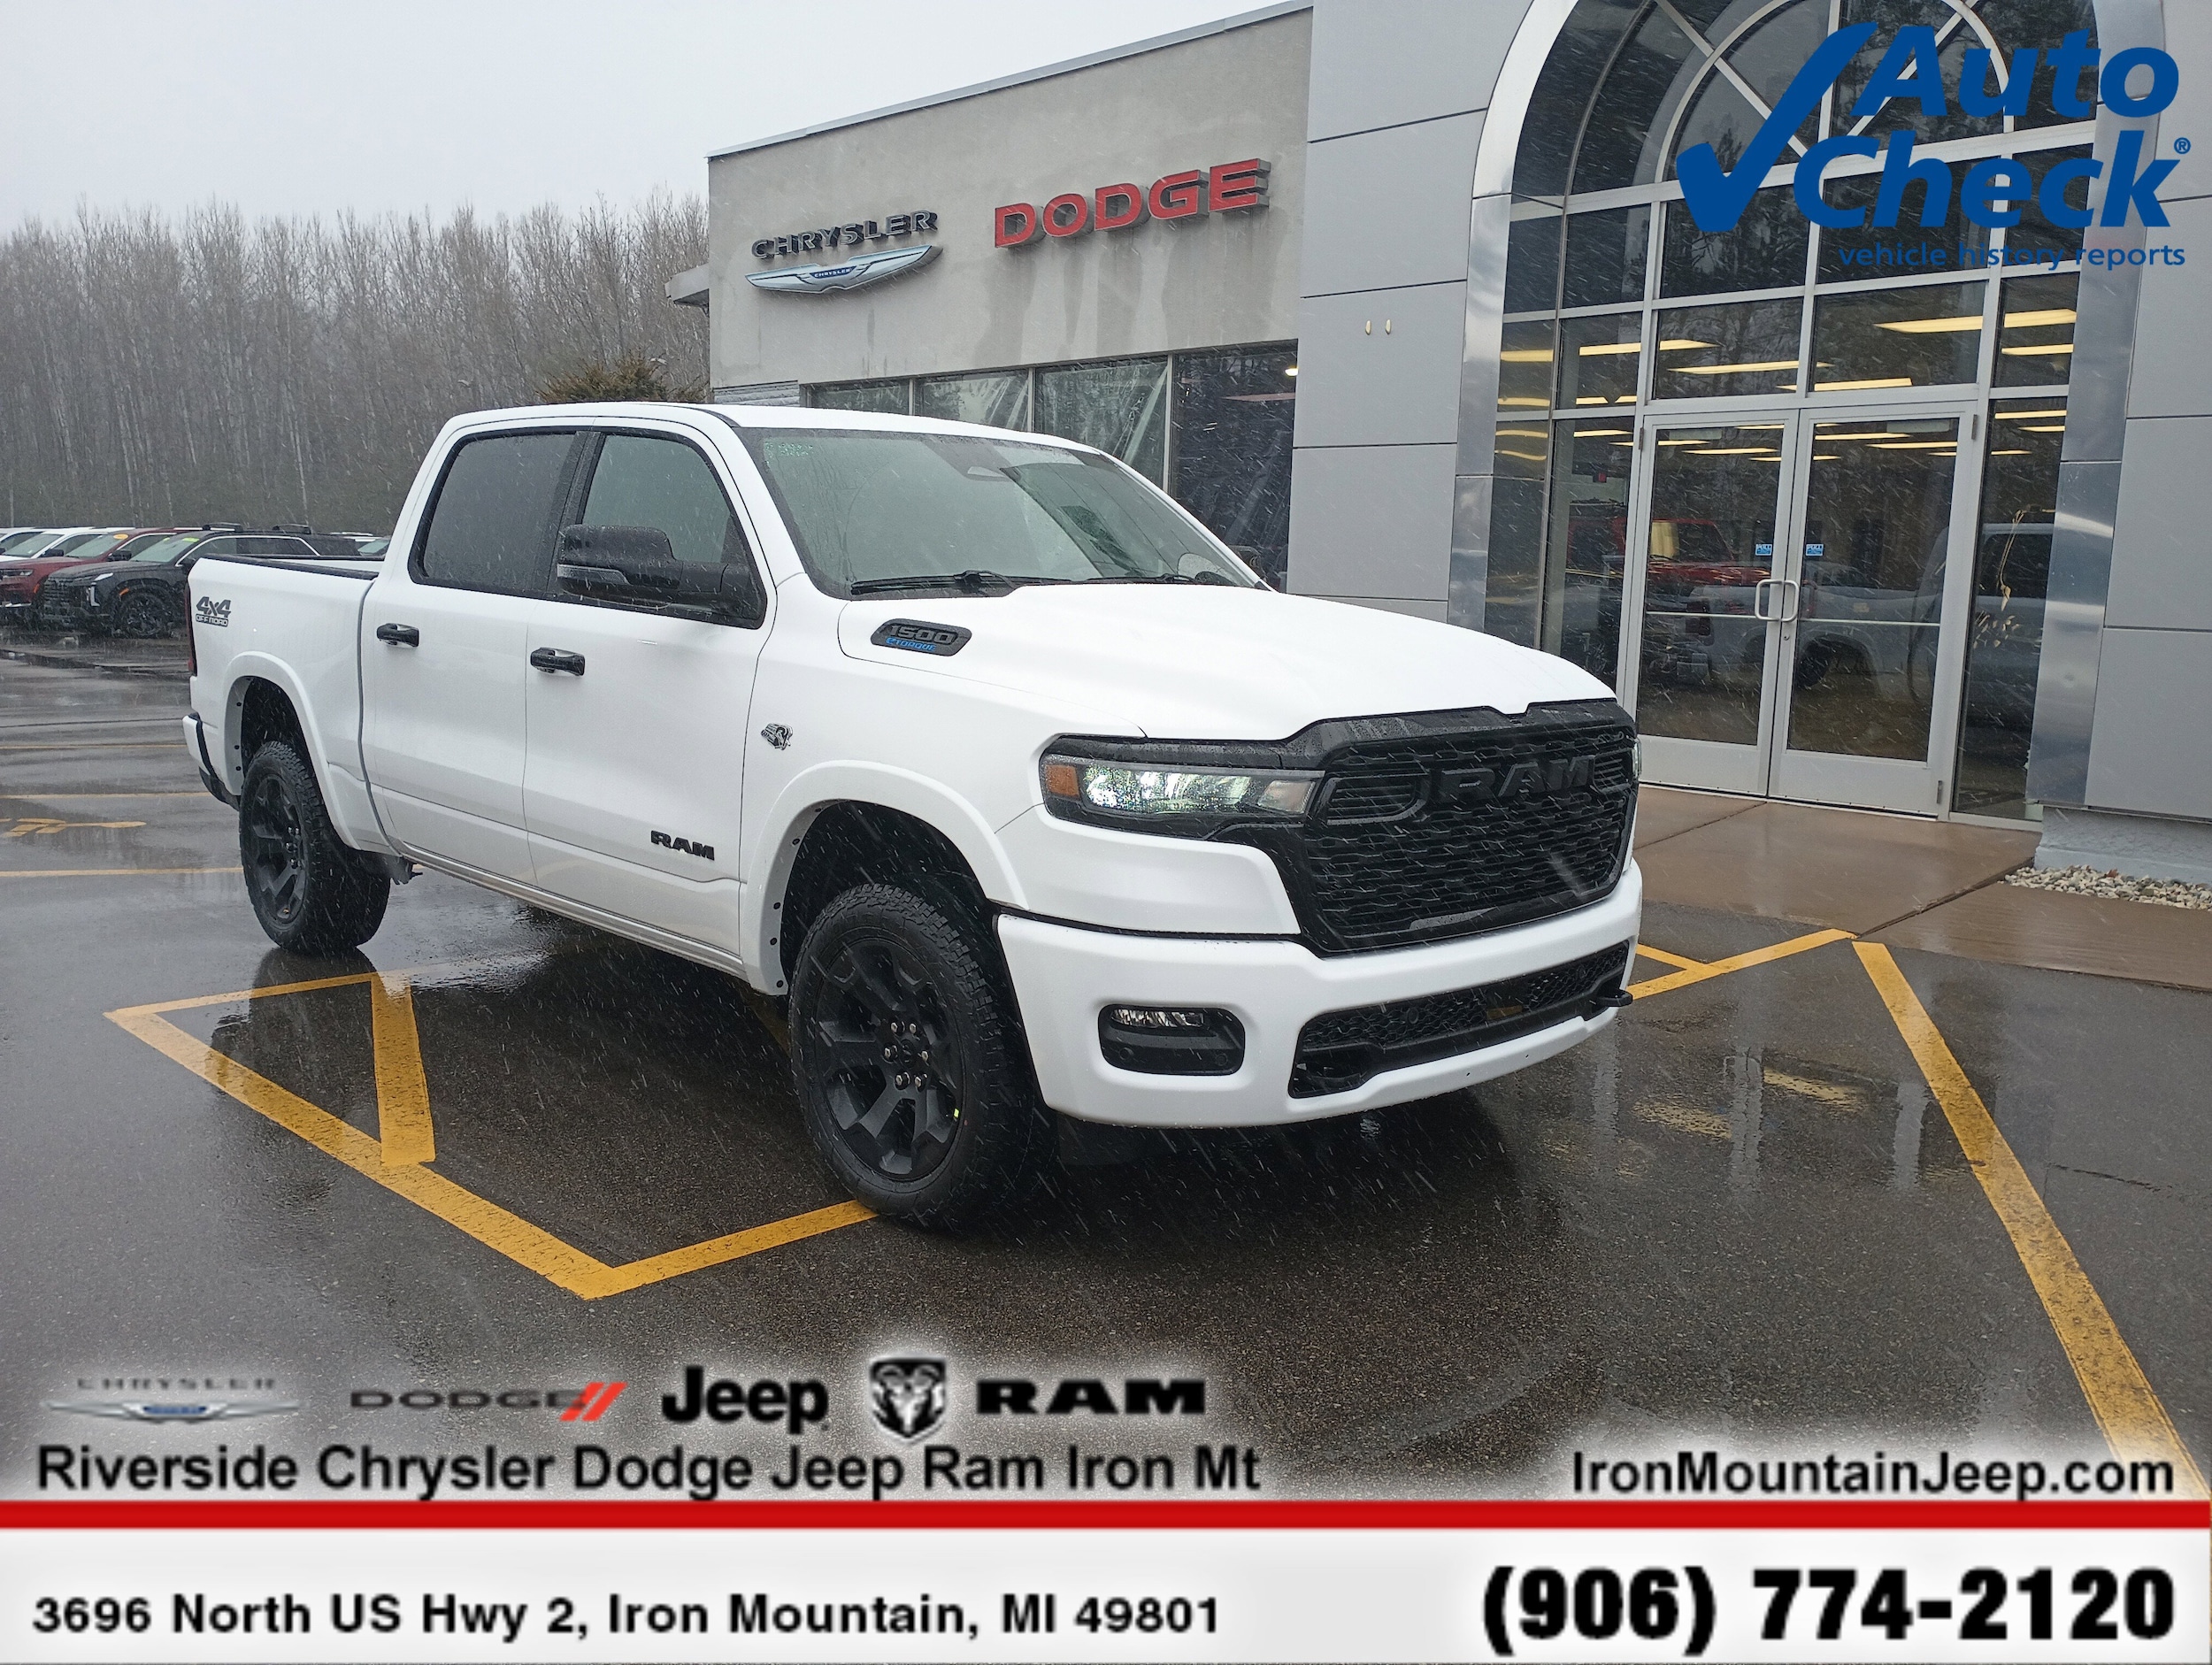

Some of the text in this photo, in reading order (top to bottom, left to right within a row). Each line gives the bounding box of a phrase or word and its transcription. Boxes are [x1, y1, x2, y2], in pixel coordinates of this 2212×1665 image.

[995, 157, 1271, 249] DODGE
[751, 210, 938, 259] CHRYSLER
[814, 268, 850, 278] CHRYSLER
[196, 596, 232, 618] 4x4
[890, 625, 955, 644] 1500
[1426, 755, 1593, 803] RAM
[650, 830, 715, 861] RAM
